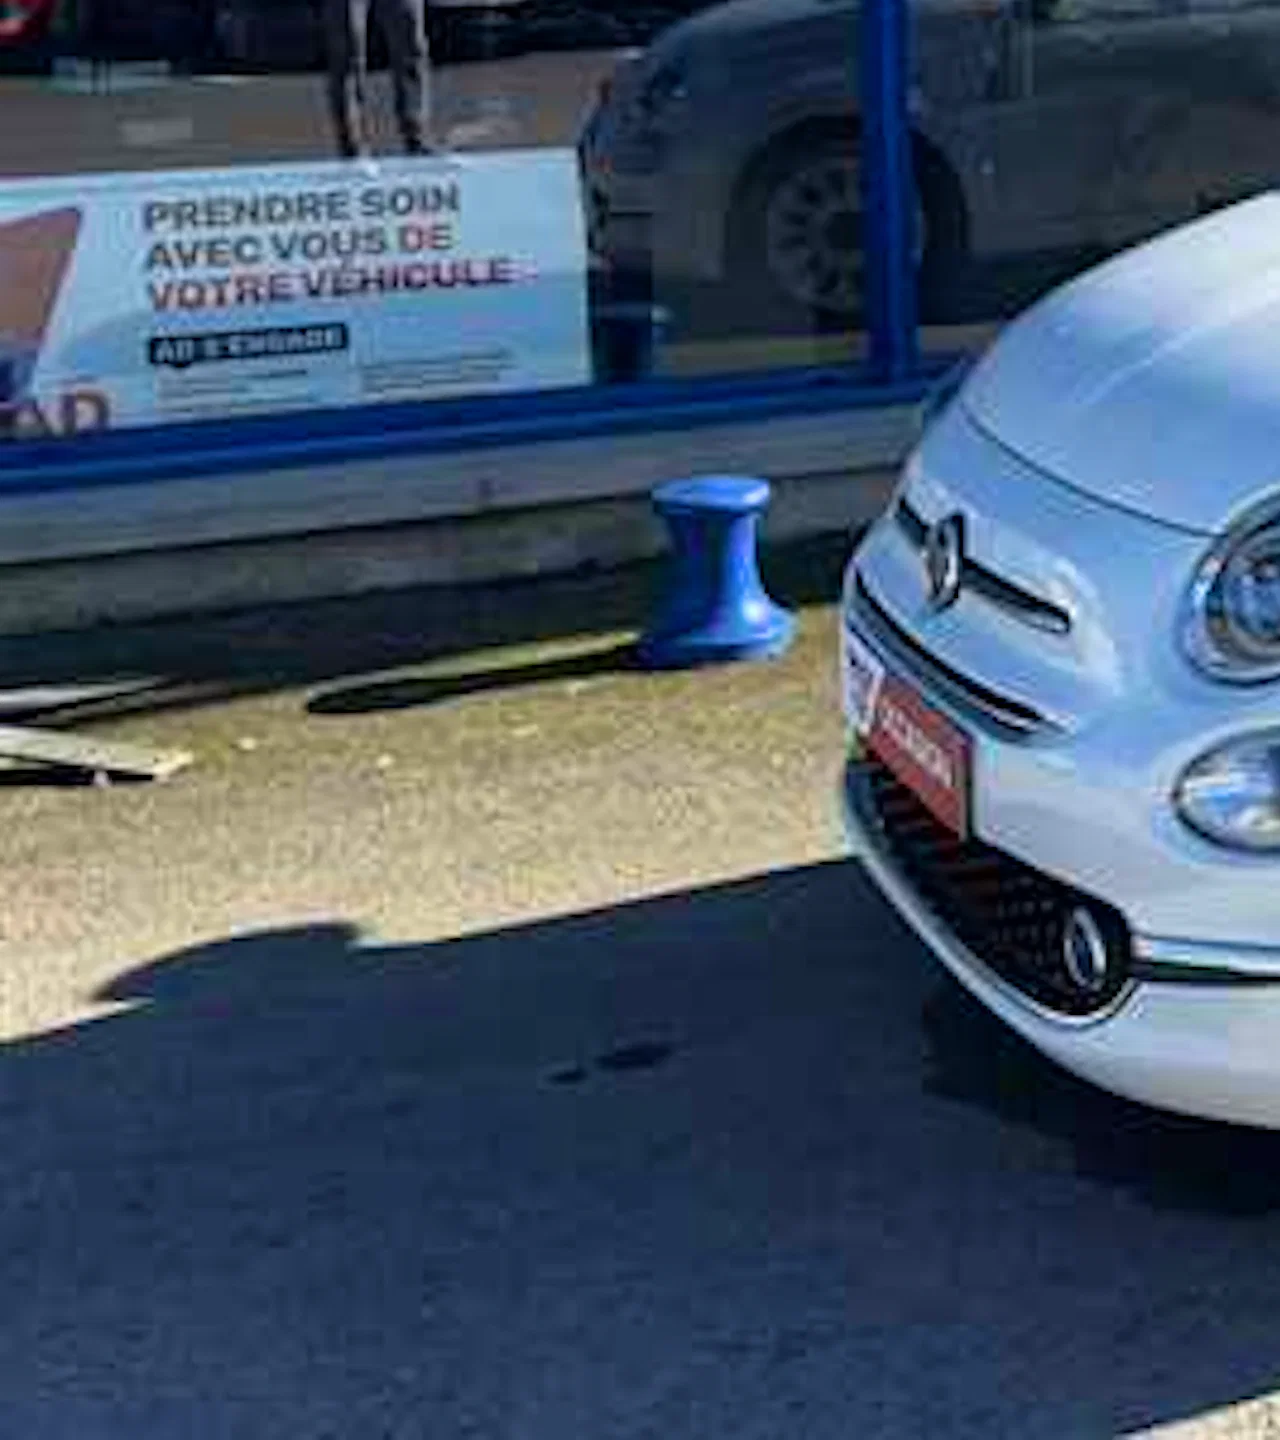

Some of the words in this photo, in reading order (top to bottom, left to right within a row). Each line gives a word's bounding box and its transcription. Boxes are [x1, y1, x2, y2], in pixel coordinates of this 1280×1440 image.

[145, 190, 352, 233] PRENDRE
[360, 182, 462, 218] SOIN
[148, 236, 263, 269] AVEC
[270, 228, 386, 261] VOUS
[400, 222, 454, 252] DE
[150, 269, 296, 311] VOTRE
